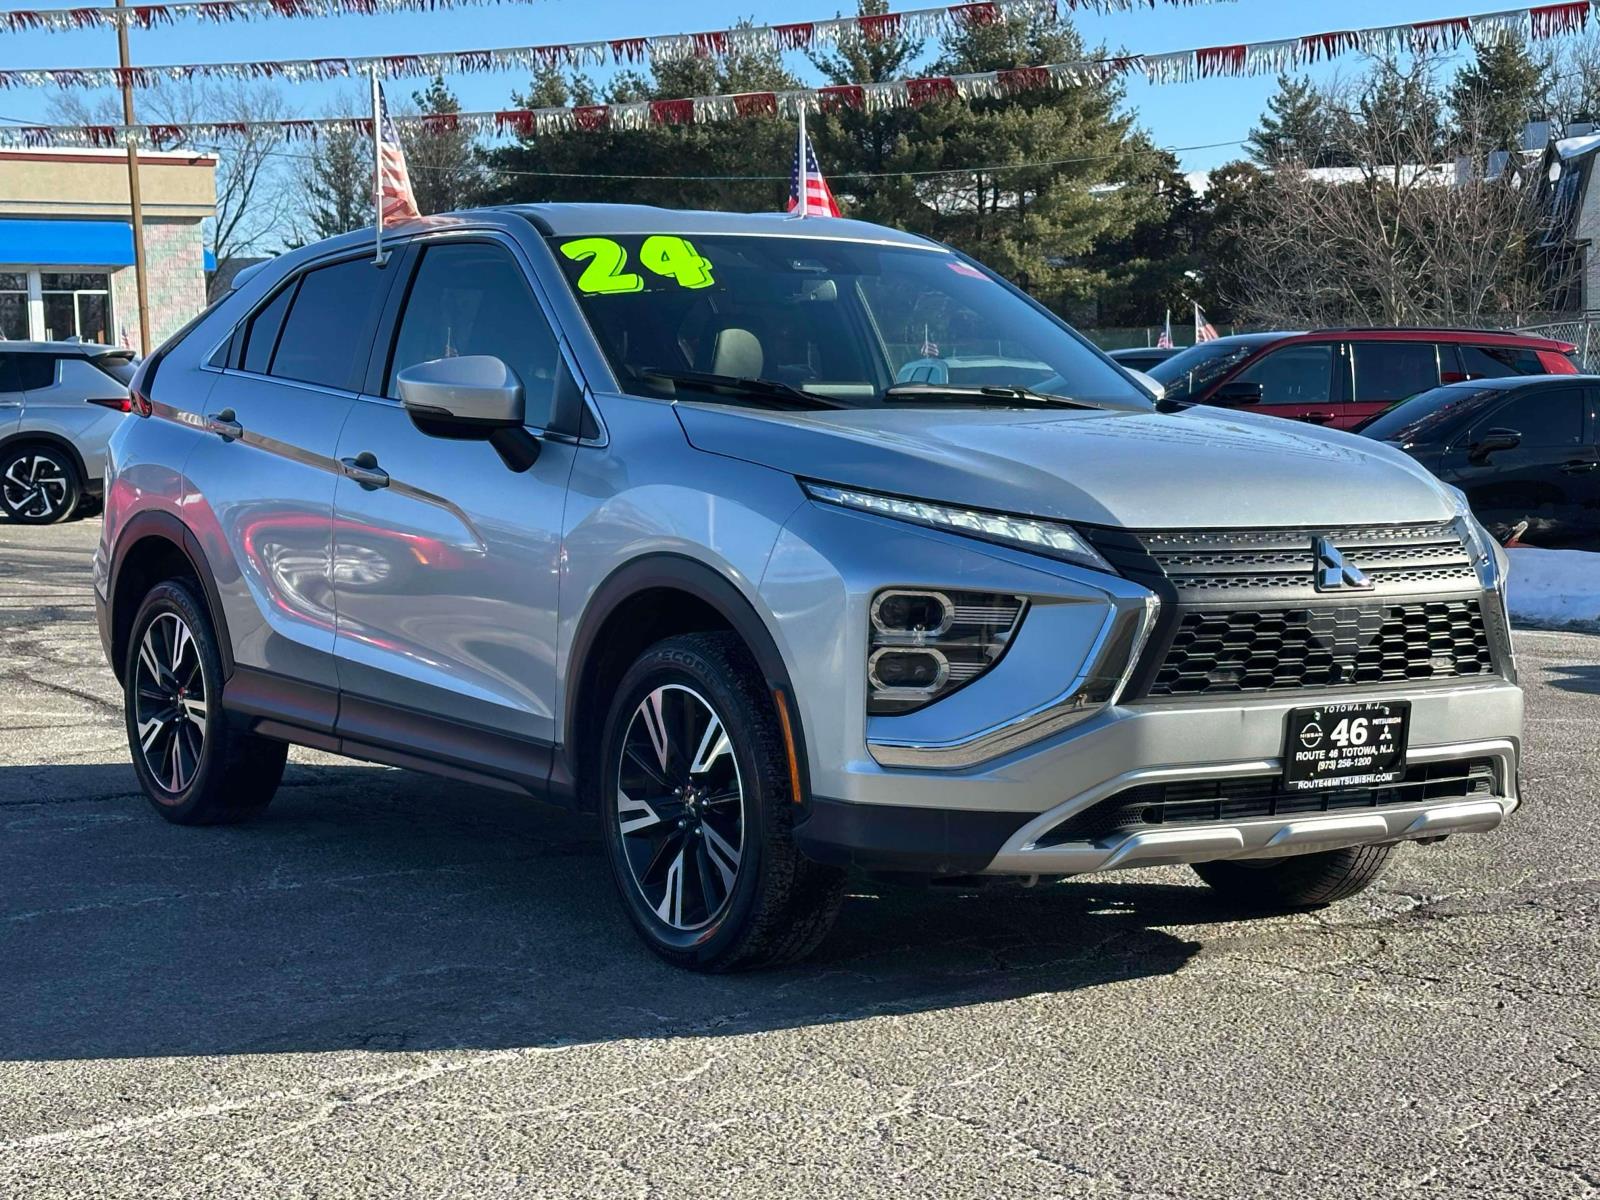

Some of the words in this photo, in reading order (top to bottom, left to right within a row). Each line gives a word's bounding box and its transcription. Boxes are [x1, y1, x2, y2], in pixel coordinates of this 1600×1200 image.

[560, 235, 715, 294] 24
[1323, 704, 1363, 714] TOTOWA,
[1330, 717, 1368, 747] 46
[1296, 750, 1326, 761] ROUTE
[1342, 746, 1378, 757] TOTOWA,
[1379, 744, 1394, 753] N.J.
[1317, 760, 1337, 772] (973)
